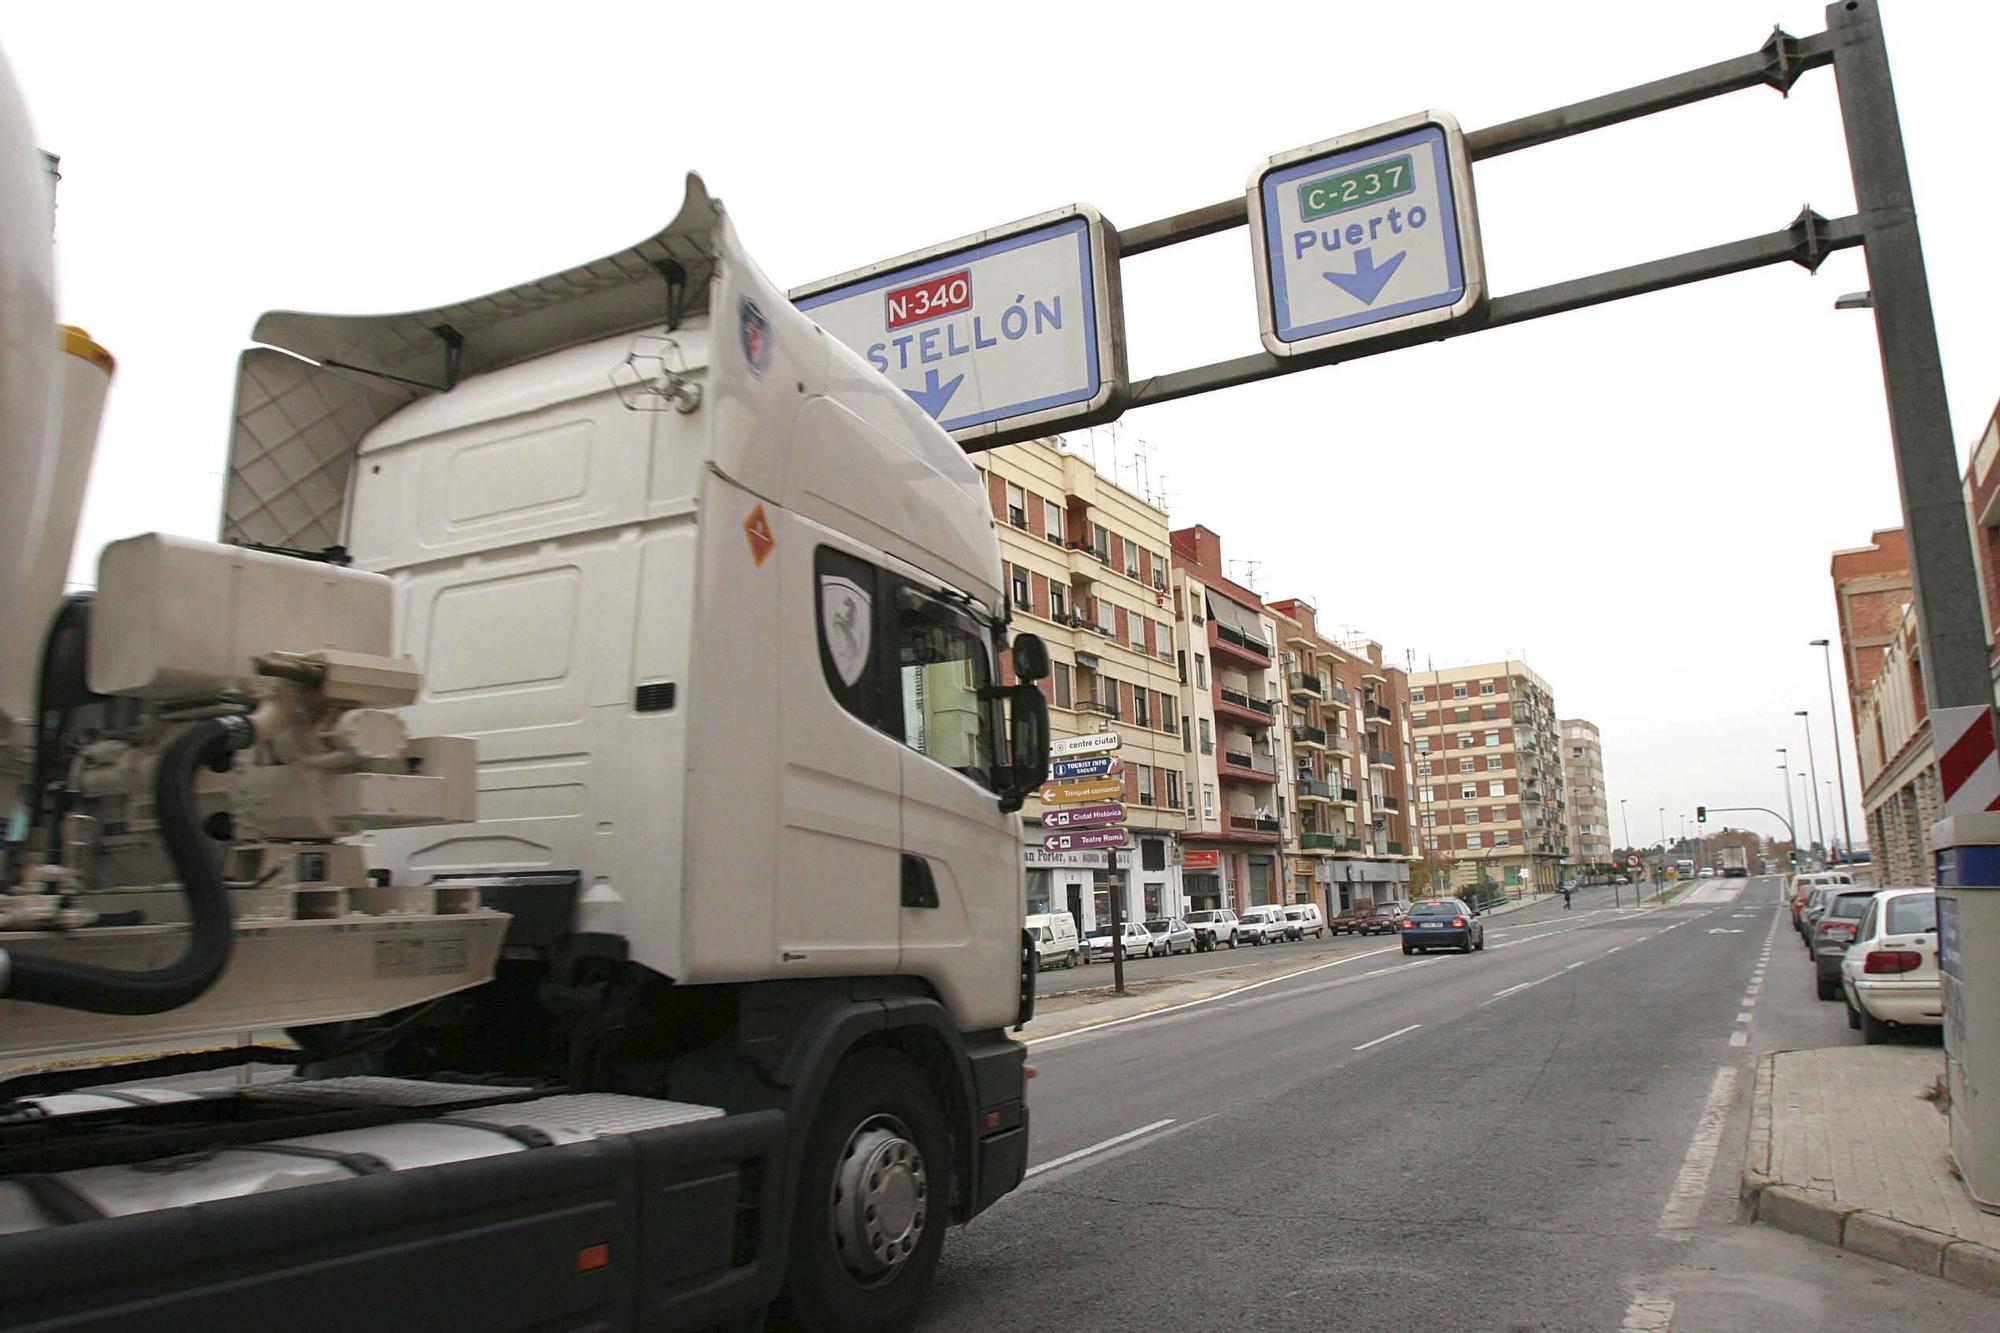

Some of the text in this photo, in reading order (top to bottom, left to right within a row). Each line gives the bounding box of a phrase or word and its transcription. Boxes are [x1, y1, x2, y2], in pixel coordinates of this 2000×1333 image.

[1308, 166, 1403, 210] C-237
[1294, 206, 1427, 260] Puerto
[888, 279, 968, 324] N-340
[1069, 736, 1116, 749] centre ciutat
[1067, 759, 1107, 769] TOURIST INFO
[1073, 812, 1092, 821] Ciutat
